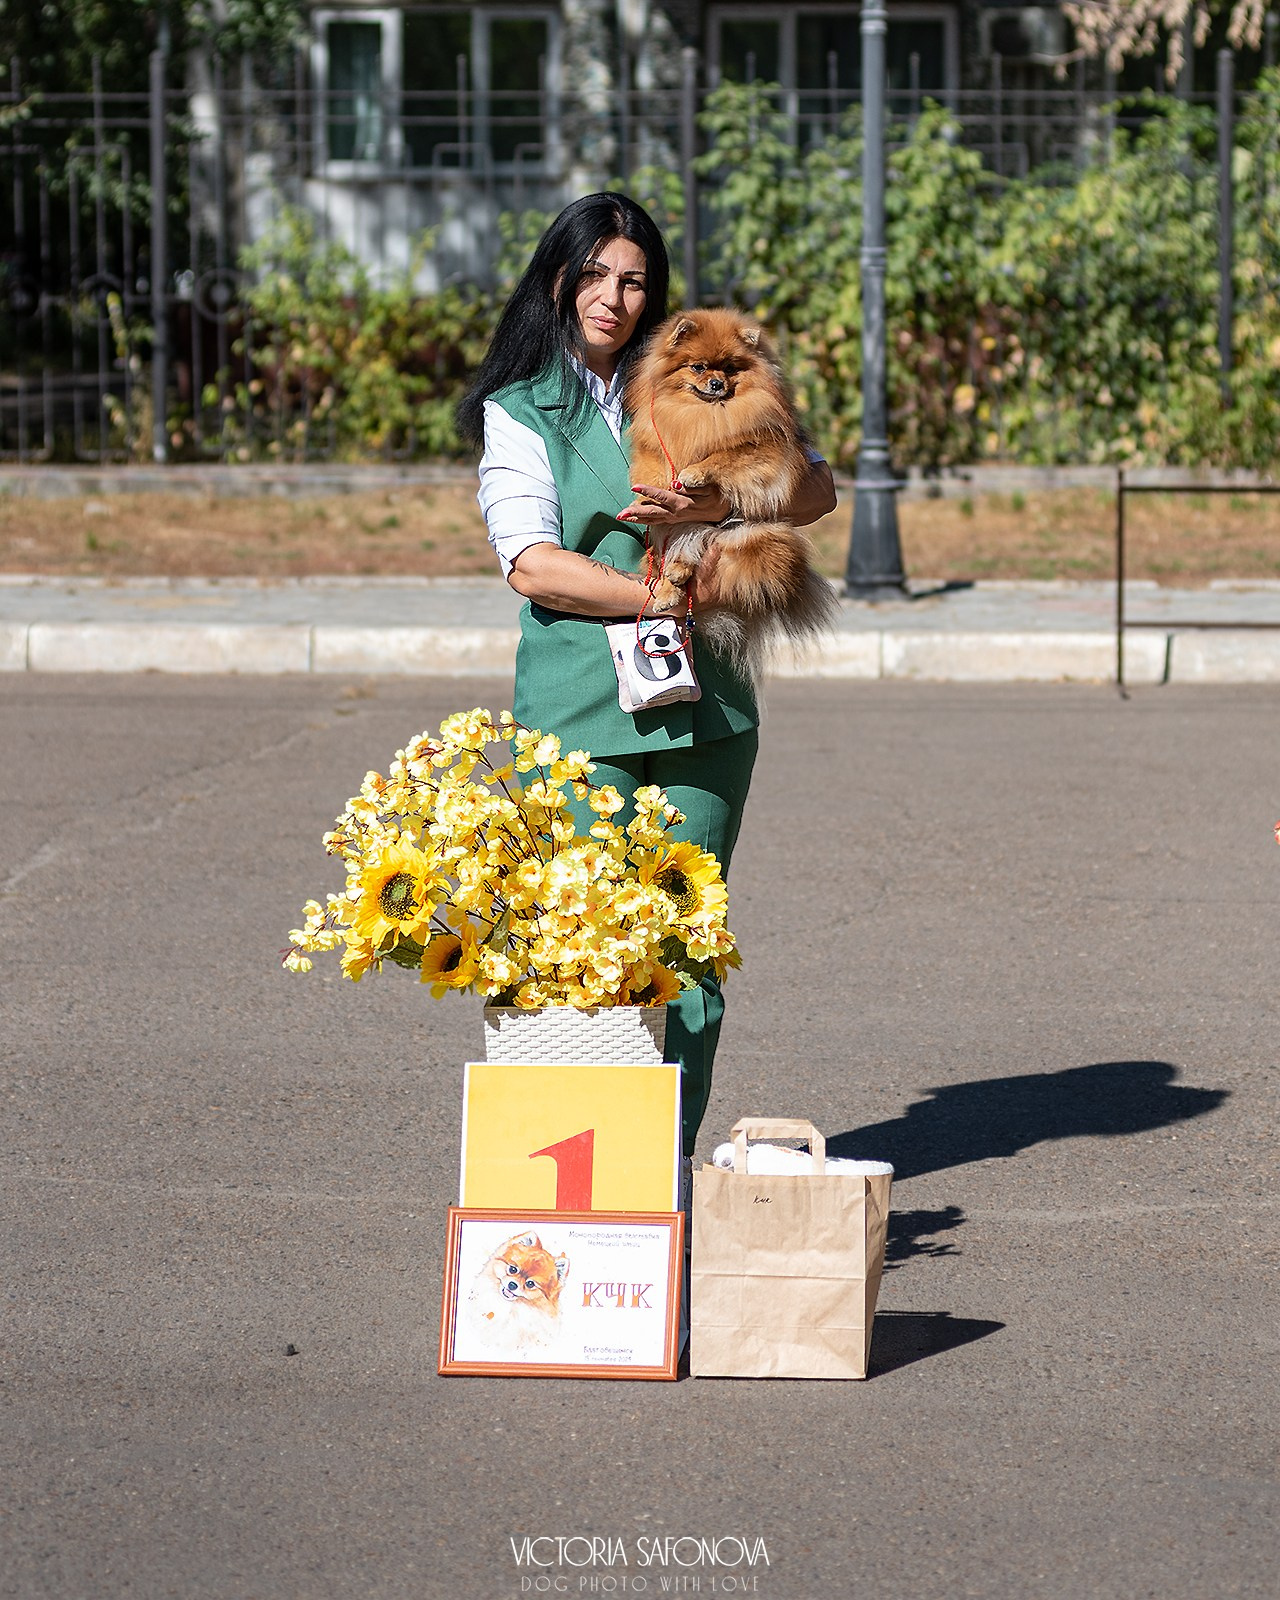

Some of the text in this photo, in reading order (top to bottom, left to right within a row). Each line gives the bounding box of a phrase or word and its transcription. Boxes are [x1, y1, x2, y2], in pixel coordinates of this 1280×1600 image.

[633, 633, 683, 682] 6
[528, 1128, 595, 1211] 1
[581, 1282, 654, 1309] КЧК
